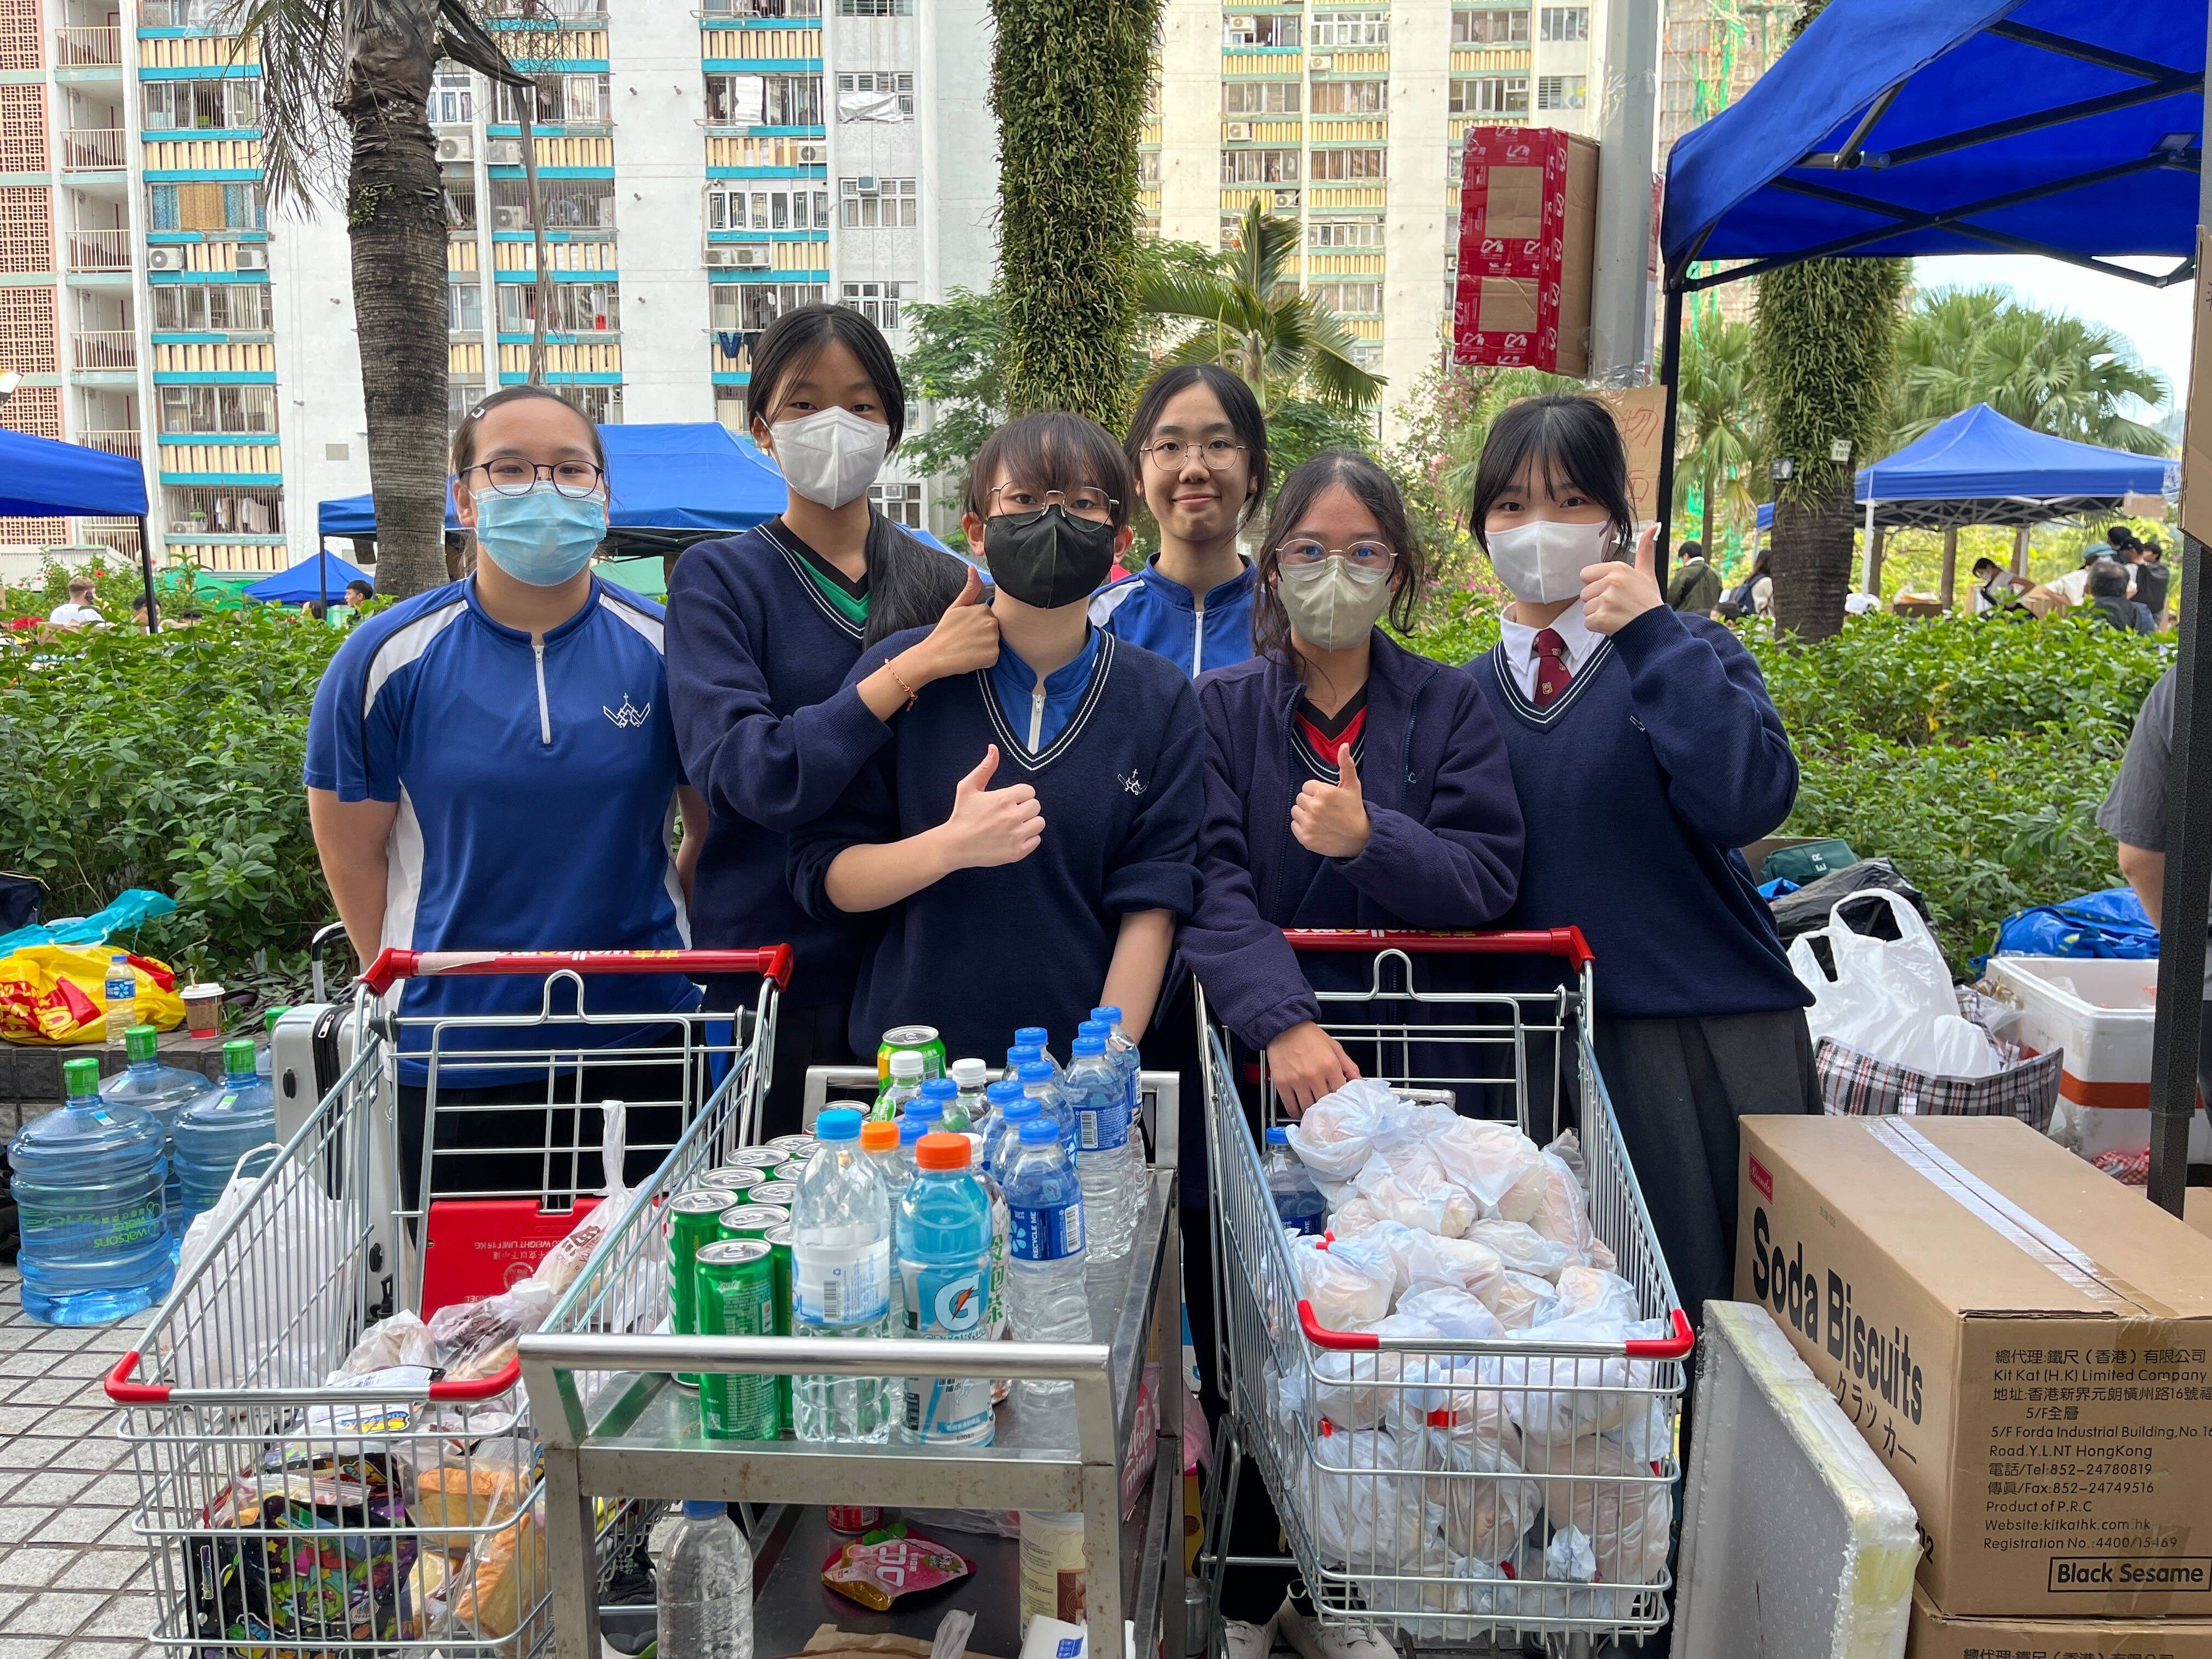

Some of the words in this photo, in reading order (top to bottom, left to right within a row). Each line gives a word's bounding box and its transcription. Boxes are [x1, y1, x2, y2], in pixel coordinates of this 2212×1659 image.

[1030, 1211, 1036, 1223] ME
[93, 1229, 148, 1249] watsons
[934, 1272, 980, 1331] G
[1753, 1206, 1818, 1345] Soda
[1827, 1267, 1923, 1426] Biscuits
[1994, 1369, 2011, 1381] Kit
[2016, 1369, 2040, 1381] Kat
[2044, 1369, 2078, 1383] (H.K)
[2082, 1369, 2134, 1381] Limited
[2138, 1369, 2207, 1384] Company
[1991, 1426, 2013, 1438] 5/F
[2016, 1426, 2053, 1438] Forda
[2057, 1426, 2118, 1438] Industrial
[2076, 1445, 2152, 1459] HongKong
[1126, 1444, 1148, 1497] mini
[1986, 1501, 2038, 1513] Product
[2041, 1500, 2055, 1513] of
[2057, 1501, 2092, 1513] P.R.C
[1984, 1537, 2064, 1551] Registration
[2057, 1562, 2113, 1583] Black
[2119, 1564, 2204, 1583] Sesame
